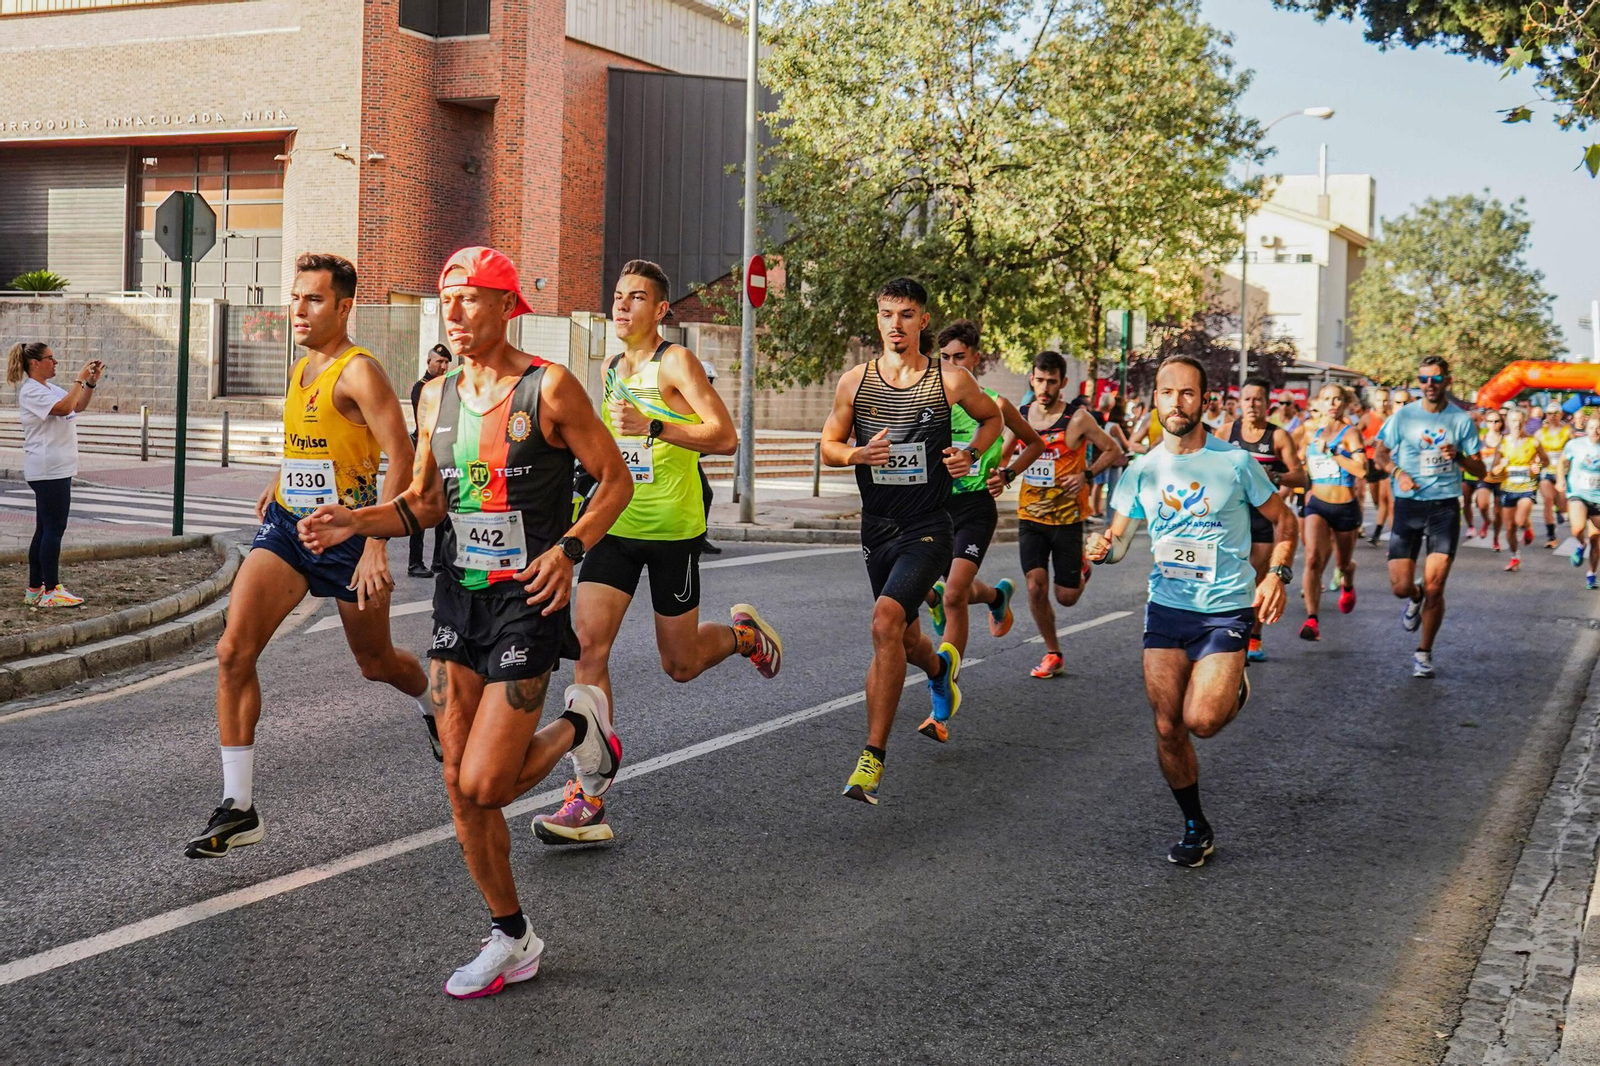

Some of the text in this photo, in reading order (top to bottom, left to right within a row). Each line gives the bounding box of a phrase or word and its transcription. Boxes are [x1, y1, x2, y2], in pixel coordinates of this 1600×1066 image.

[104, 112, 226, 128] INMACULADA
[494, 465, 533, 478] TEST
[286, 472, 326, 488] 1330
[469, 527, 505, 547] 442
[1174, 548, 1196, 563] 28
